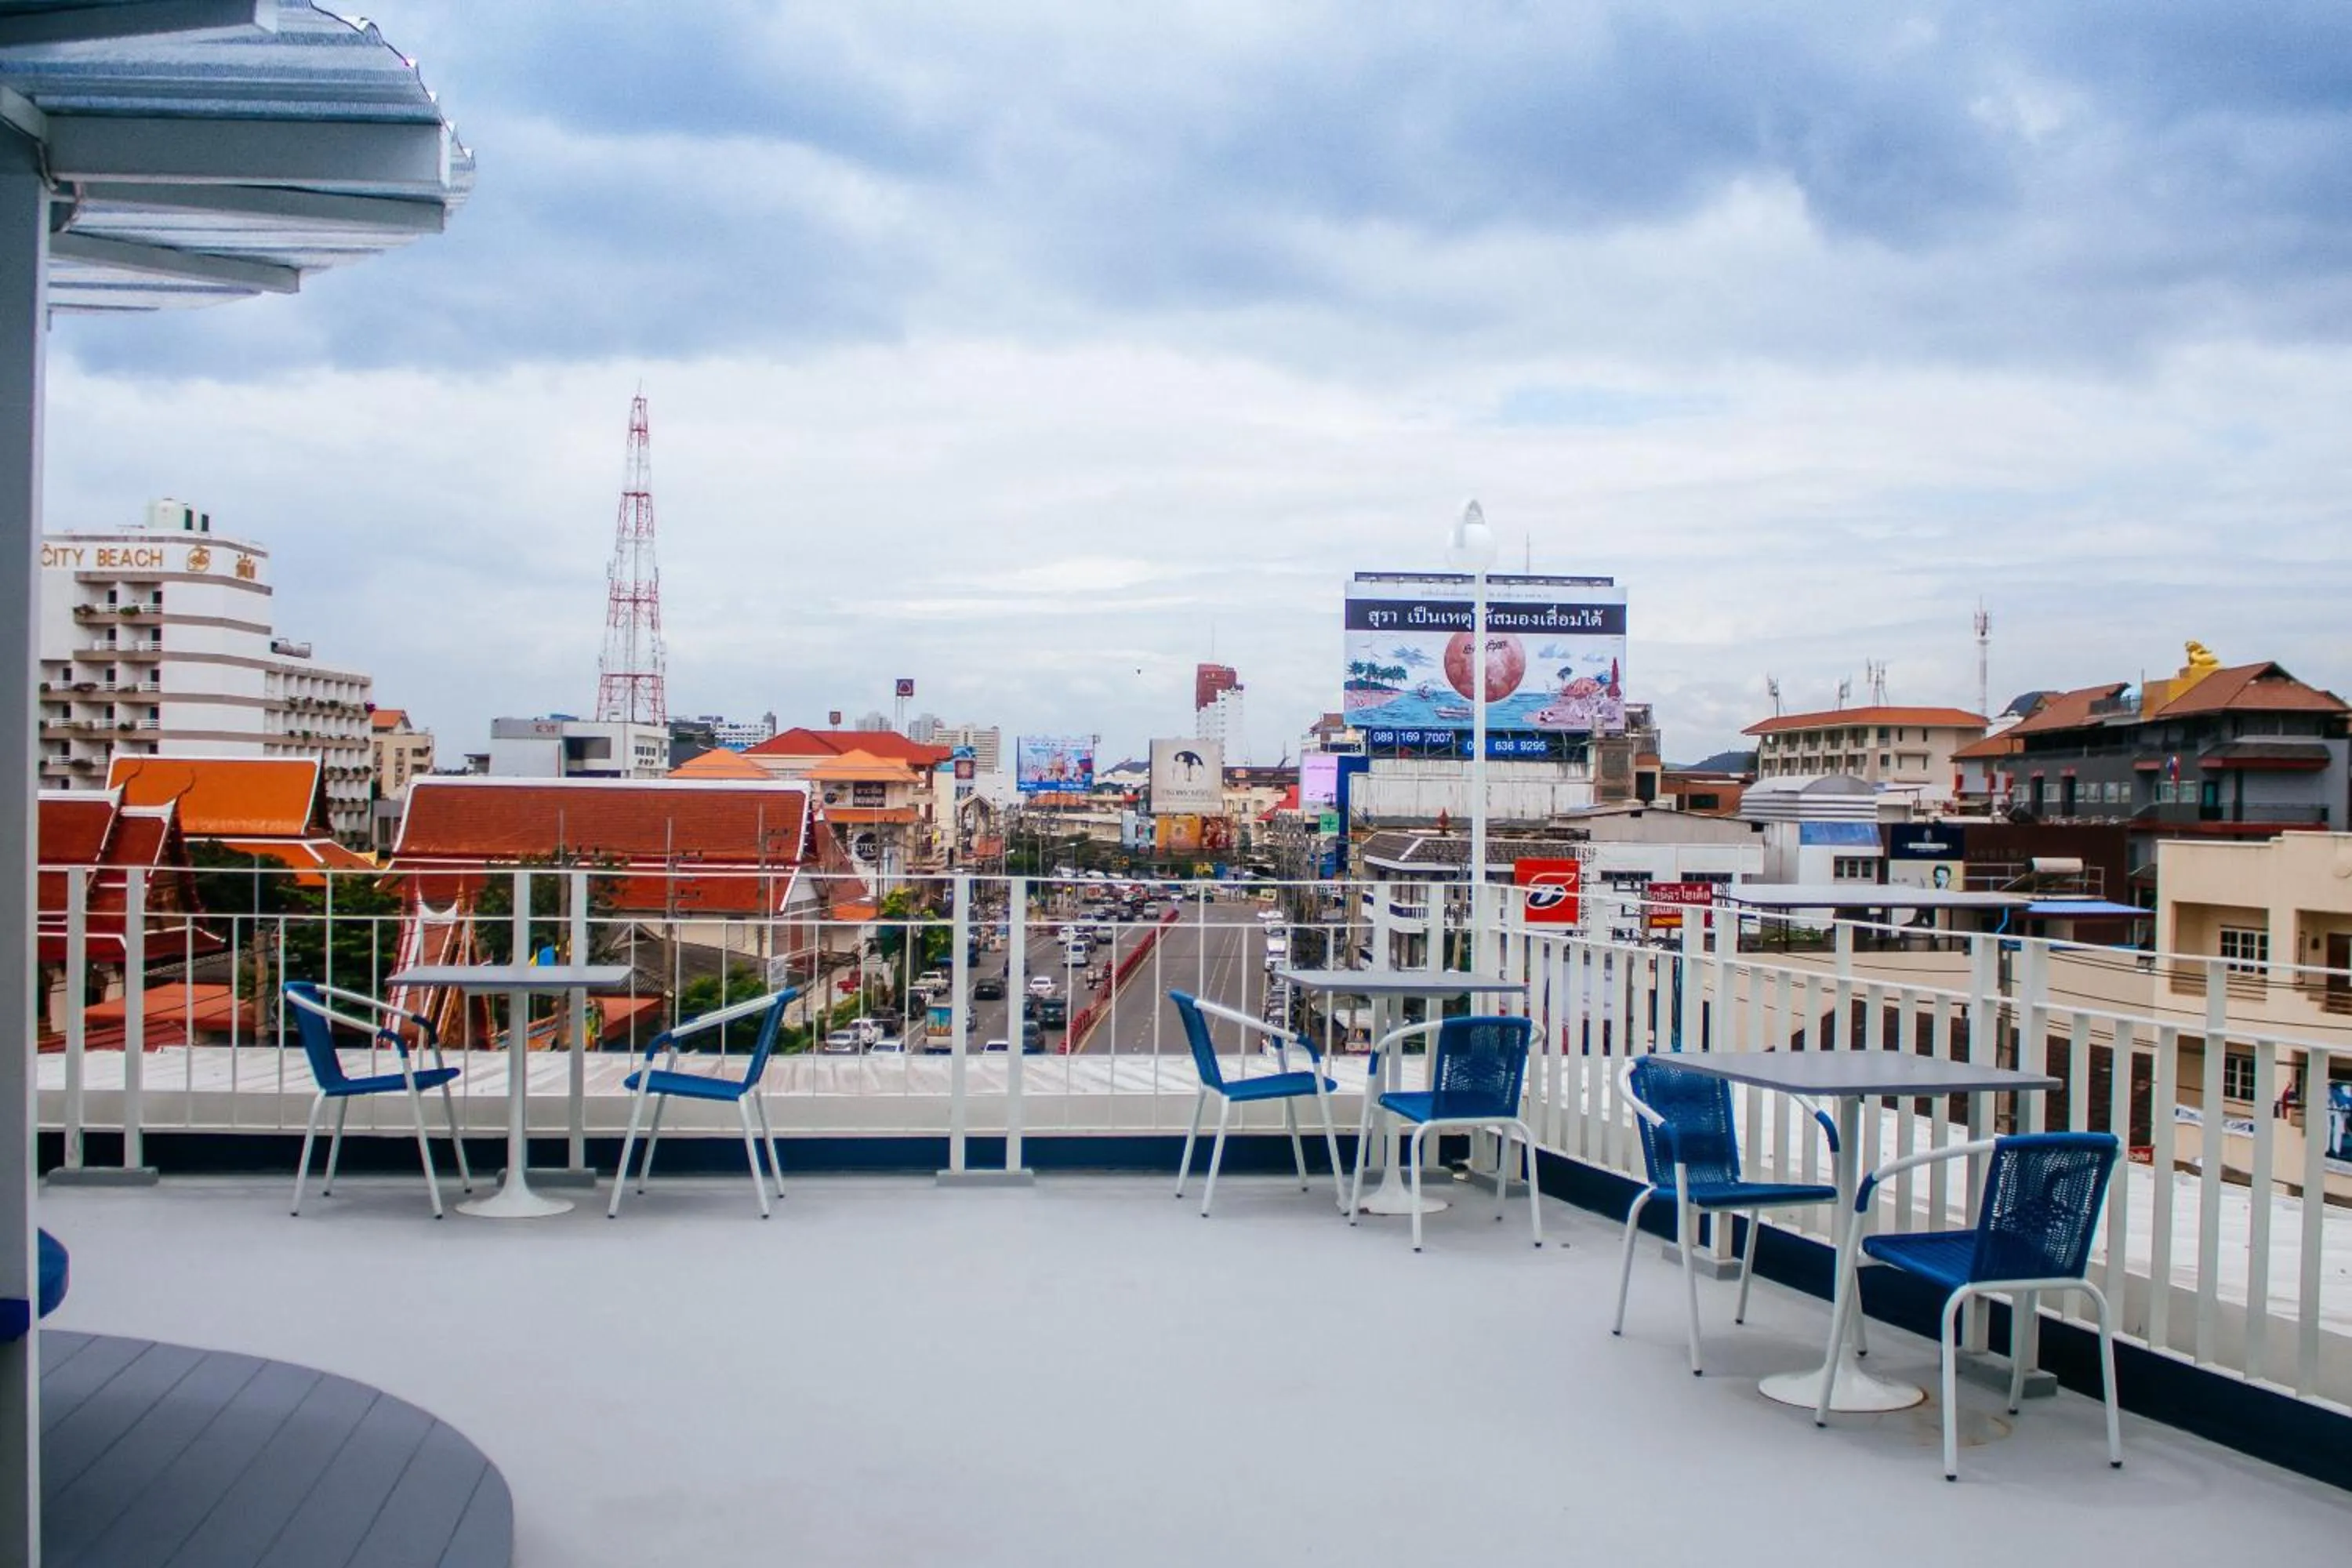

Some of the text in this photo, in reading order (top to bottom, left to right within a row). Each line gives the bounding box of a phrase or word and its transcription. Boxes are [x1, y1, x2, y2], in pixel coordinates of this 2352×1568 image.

[41, 544, 163, 568] CITY BEACH
[1368, 604, 1603, 630] สุรา เป็นเหตุห้สมองเสื่อมได้
[1400, 731, 1420, 743] 169
[1425, 732, 1451, 743] 7007
[1495, 741, 1515, 751] 636
